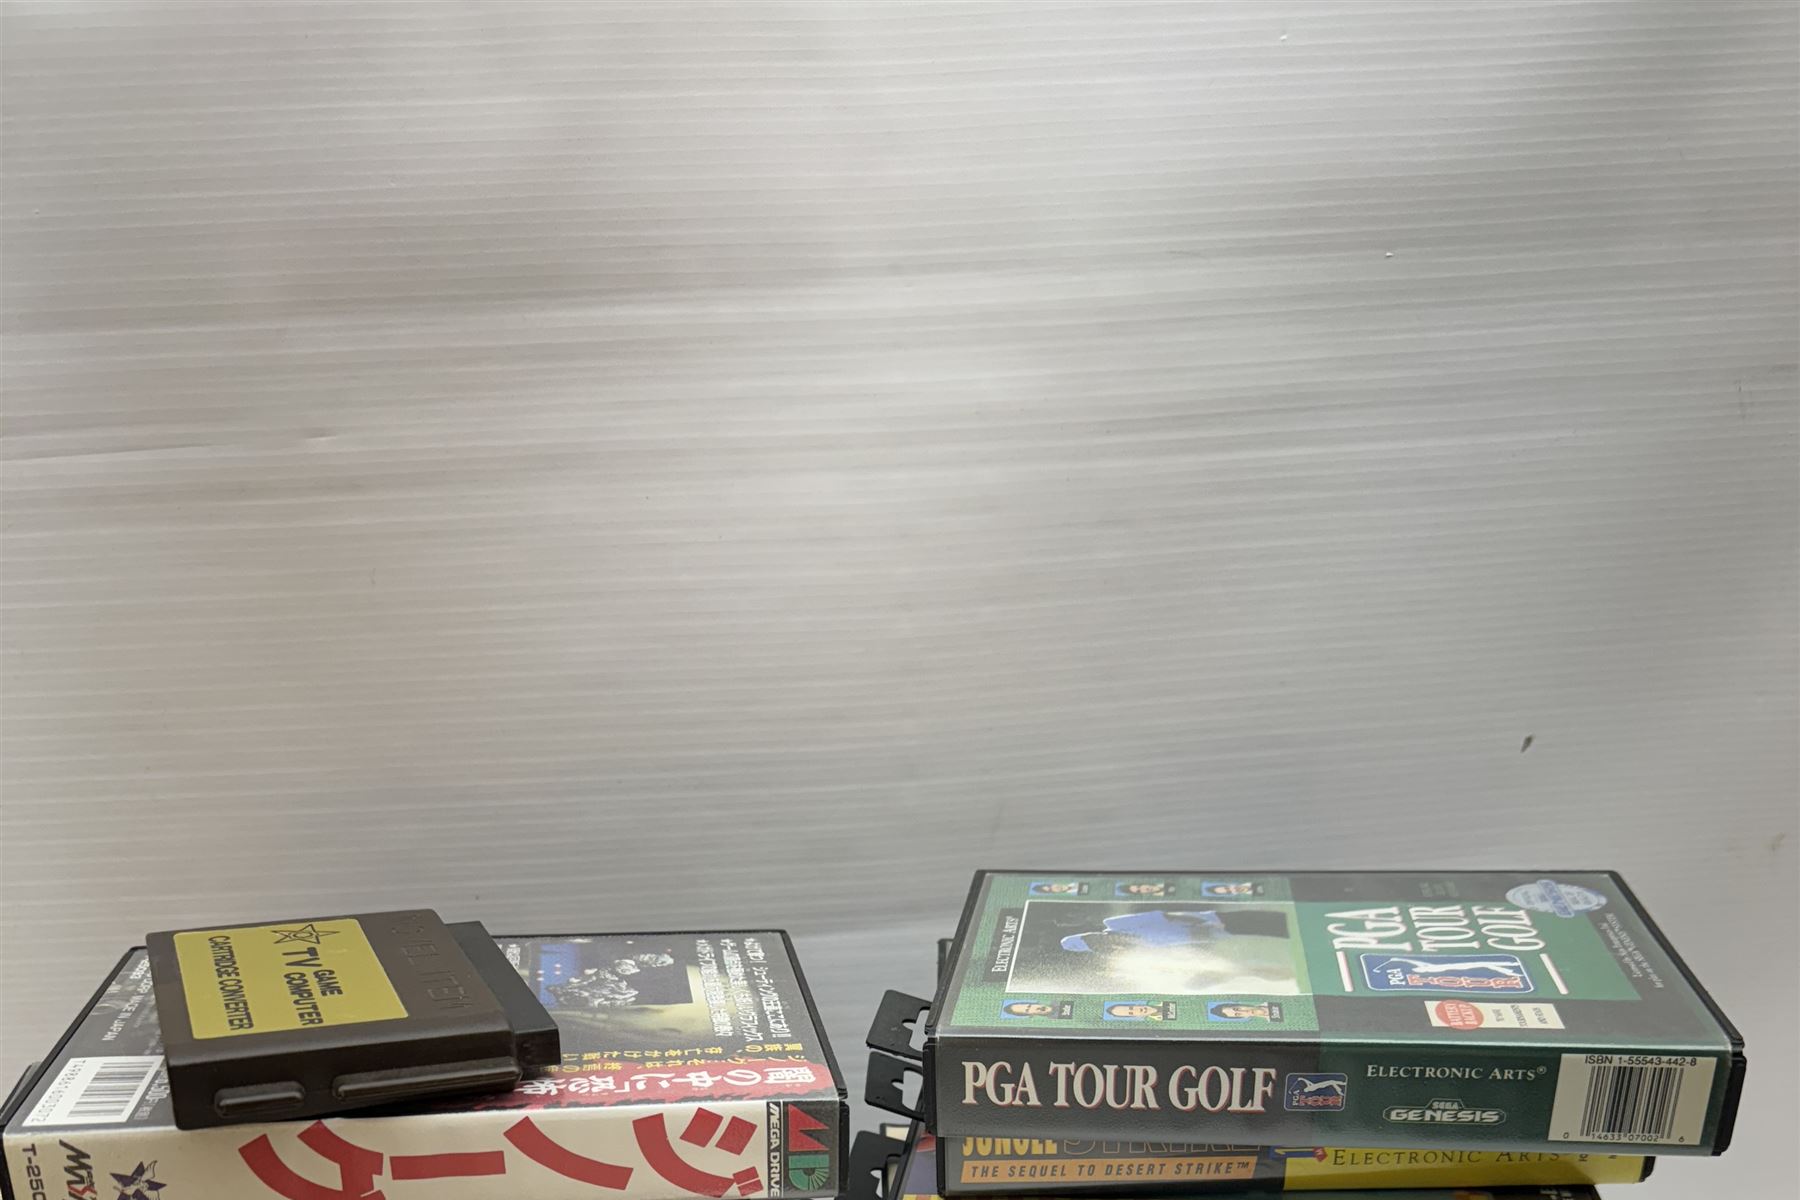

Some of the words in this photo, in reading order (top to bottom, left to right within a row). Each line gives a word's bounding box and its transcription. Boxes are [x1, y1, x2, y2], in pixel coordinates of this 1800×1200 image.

[1325, 906, 1412, 952] PGA
[1410, 904, 1481, 953] TOUR
[1472, 904, 1547, 951] GOLF
[208, 935, 241, 979] CARTRIDGE
[282, 946, 322, 968] TV
[313, 969, 343, 997] GAME
[992, 934, 1014, 973] ELECTRONIC
[283, 972, 324, 1026] COMPUTER
[1386, 968, 1406, 986] PGA
[1406, 974, 1524, 989] TOUR
[218, 978, 255, 1031] CONVERTER
[1367, 1065, 1483, 1080] ELECTRONIC
[1585, 1055, 1612, 1066] ISBN
[1617, 1056, 1698, 1067] 1-55543-442-8
[962, 1061, 1041, 1108] PGA
[1049, 1061, 1158, 1110] TOUR
[1169, 1066, 1276, 1113] GOLF
[1432, 1100, 1459, 1110] SEGA
[768, 1103, 781, 1146] MEGA
[1390, 1108, 1500, 1124] GENESIS
[1562, 1132, 1570, 1140] 0
[1591, 1132, 1622, 1142] 14633
[1627, 1132, 1660, 1143] 07002
[769, 1150, 780, 1198] DRIVE
[971, 1166, 1000, 1178] THE
[1008, 1164, 1067, 1178] SEQUEL
[1077, 1164, 1095, 1177] TO
[1104, 1163, 1166, 1177] DESERT
[1333, 1150, 1483, 1167] ELECTRONIC
